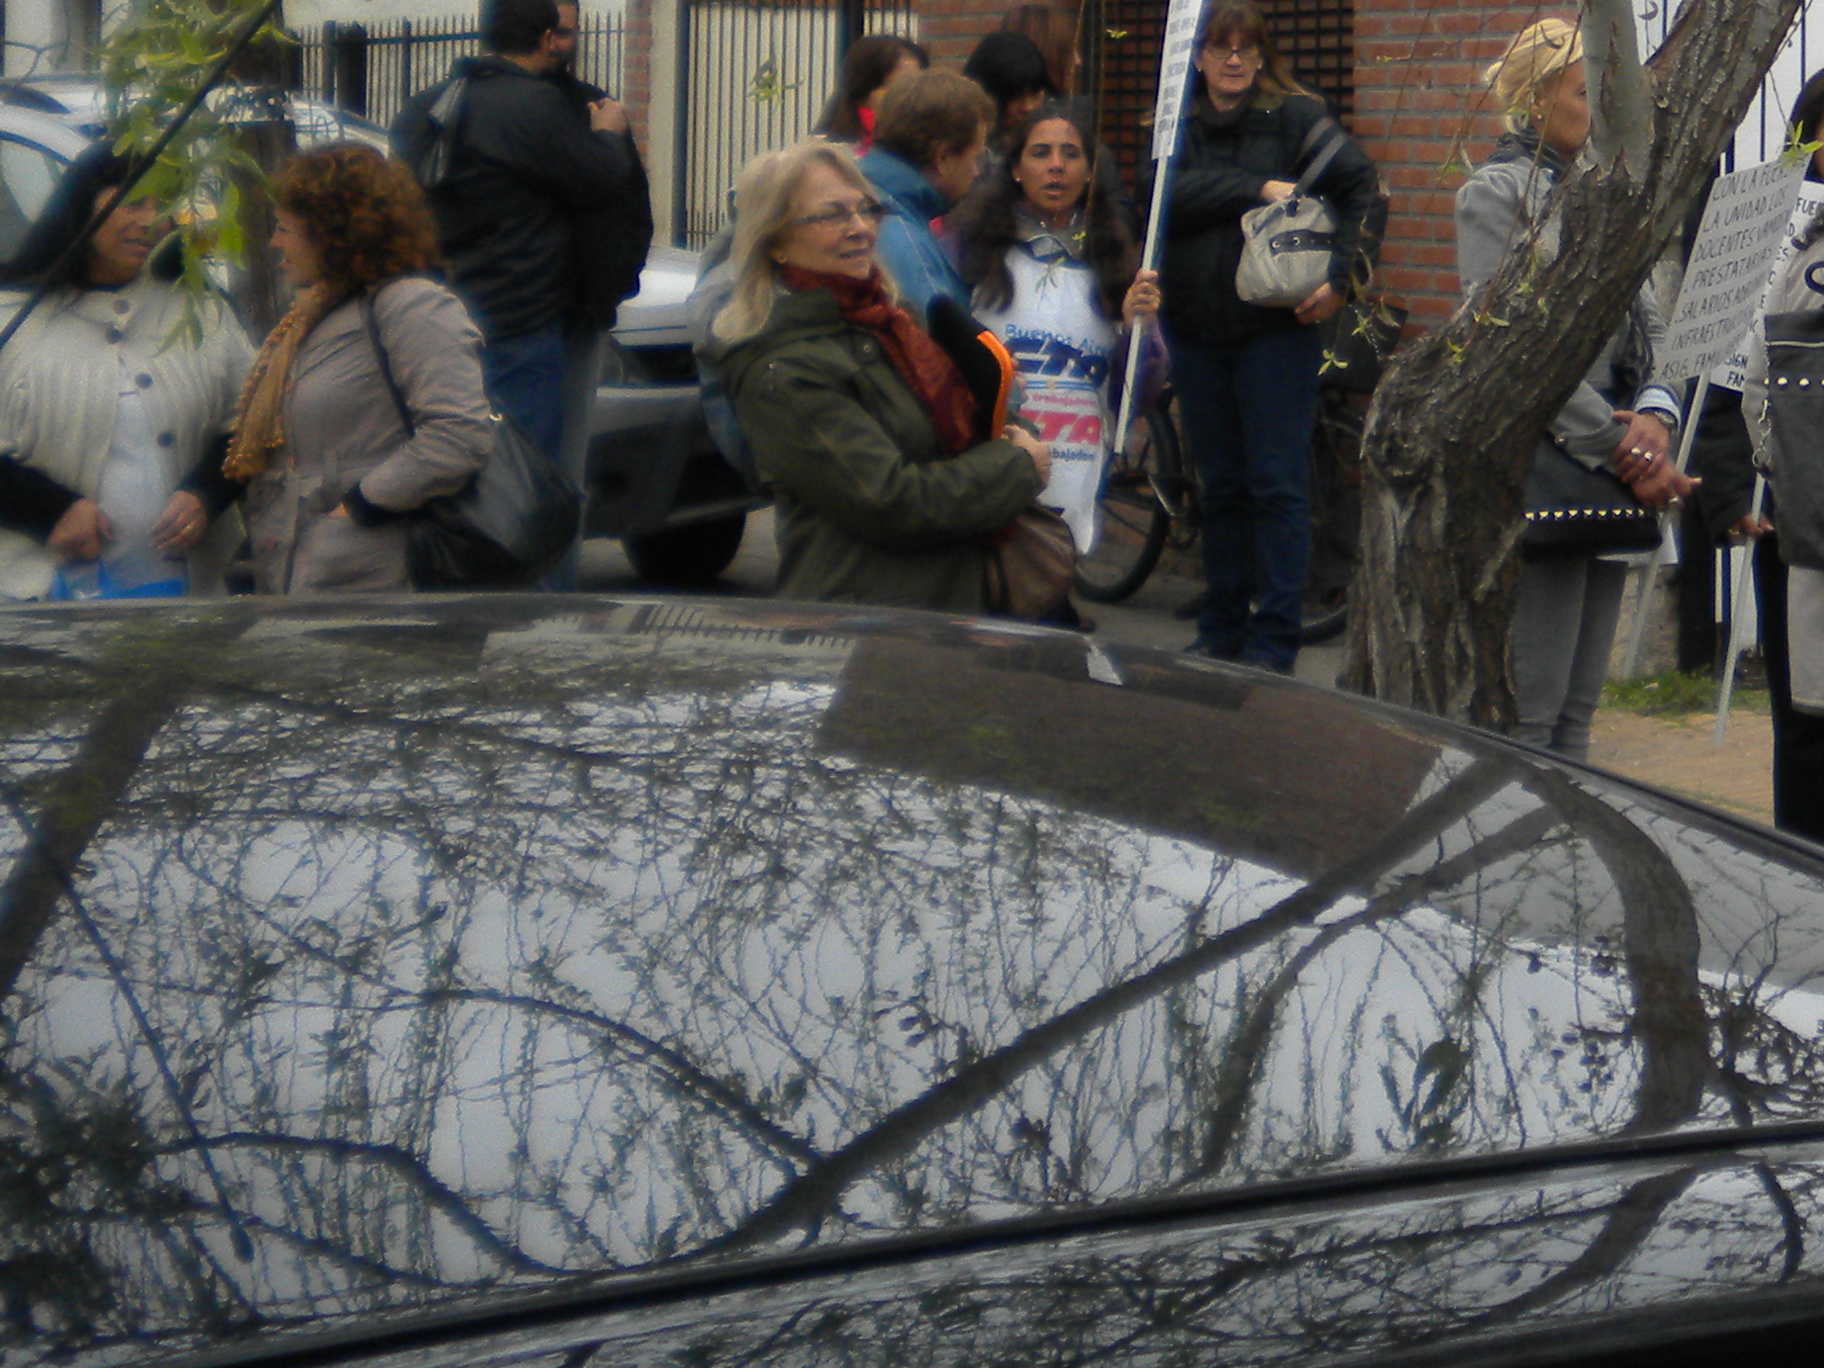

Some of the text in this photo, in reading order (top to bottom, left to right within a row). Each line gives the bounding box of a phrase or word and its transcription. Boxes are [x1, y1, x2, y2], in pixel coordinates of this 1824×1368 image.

[1702, 210, 1720, 233] LA
[1723, 195, 1768, 227] UNIDAD
[1694, 225, 1757, 263] DOCENTES
